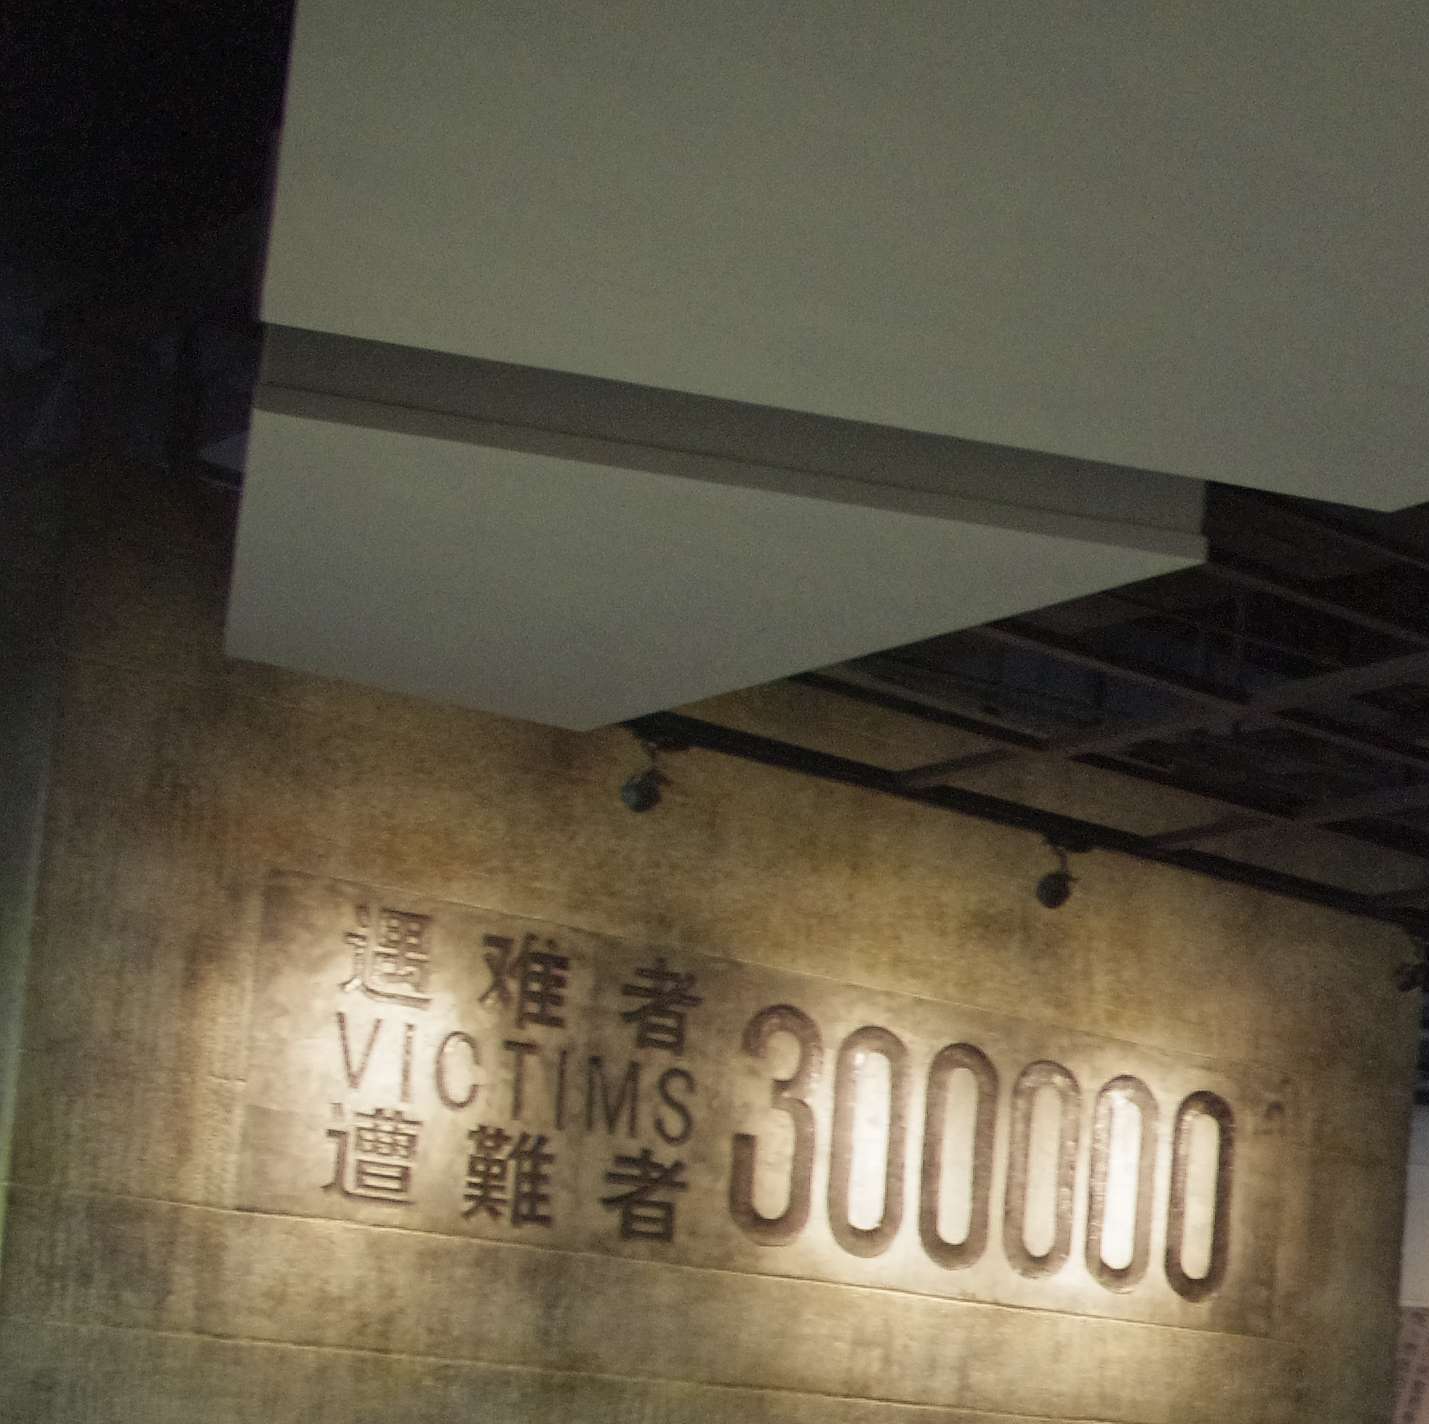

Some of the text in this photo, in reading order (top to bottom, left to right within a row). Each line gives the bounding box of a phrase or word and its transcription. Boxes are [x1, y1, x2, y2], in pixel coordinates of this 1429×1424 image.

[340, 904, 702, 1055] 遇难者
[336, 1012, 696, 1145] VICTIMS
[322, 1103, 689, 1243] 遭難者
[729, 1003, 1236, 1303] 300000
